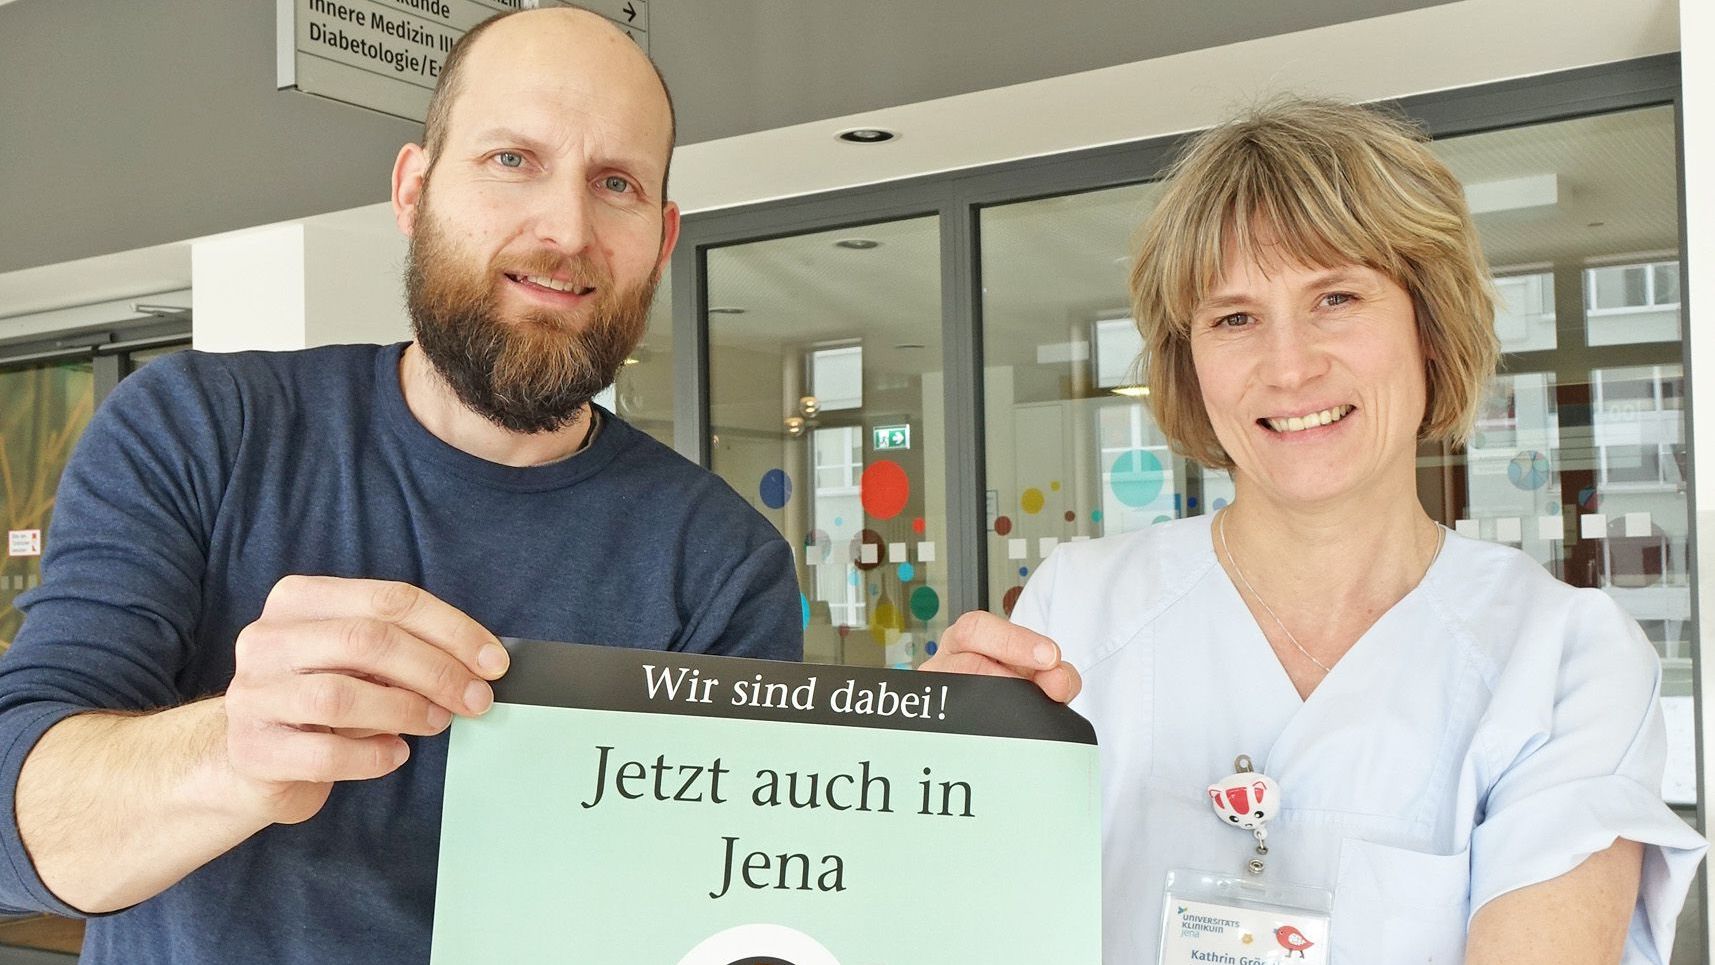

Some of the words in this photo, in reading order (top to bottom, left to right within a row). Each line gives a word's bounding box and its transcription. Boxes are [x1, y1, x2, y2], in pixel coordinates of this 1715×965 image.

[309, 0, 366, 26] Innere
[371, 12, 434, 48] Medizin
[642, 664, 719, 704] Wir
[731, 673, 817, 711] sind
[830, 680, 949, 720] dabei!
[581, 745, 730, 809] Jetzt
[751, 761, 895, 813] auch
[917, 767, 975, 817] in
[709, 836, 847, 899] Jena
[1191, 949, 1235, 965] Kathrin
